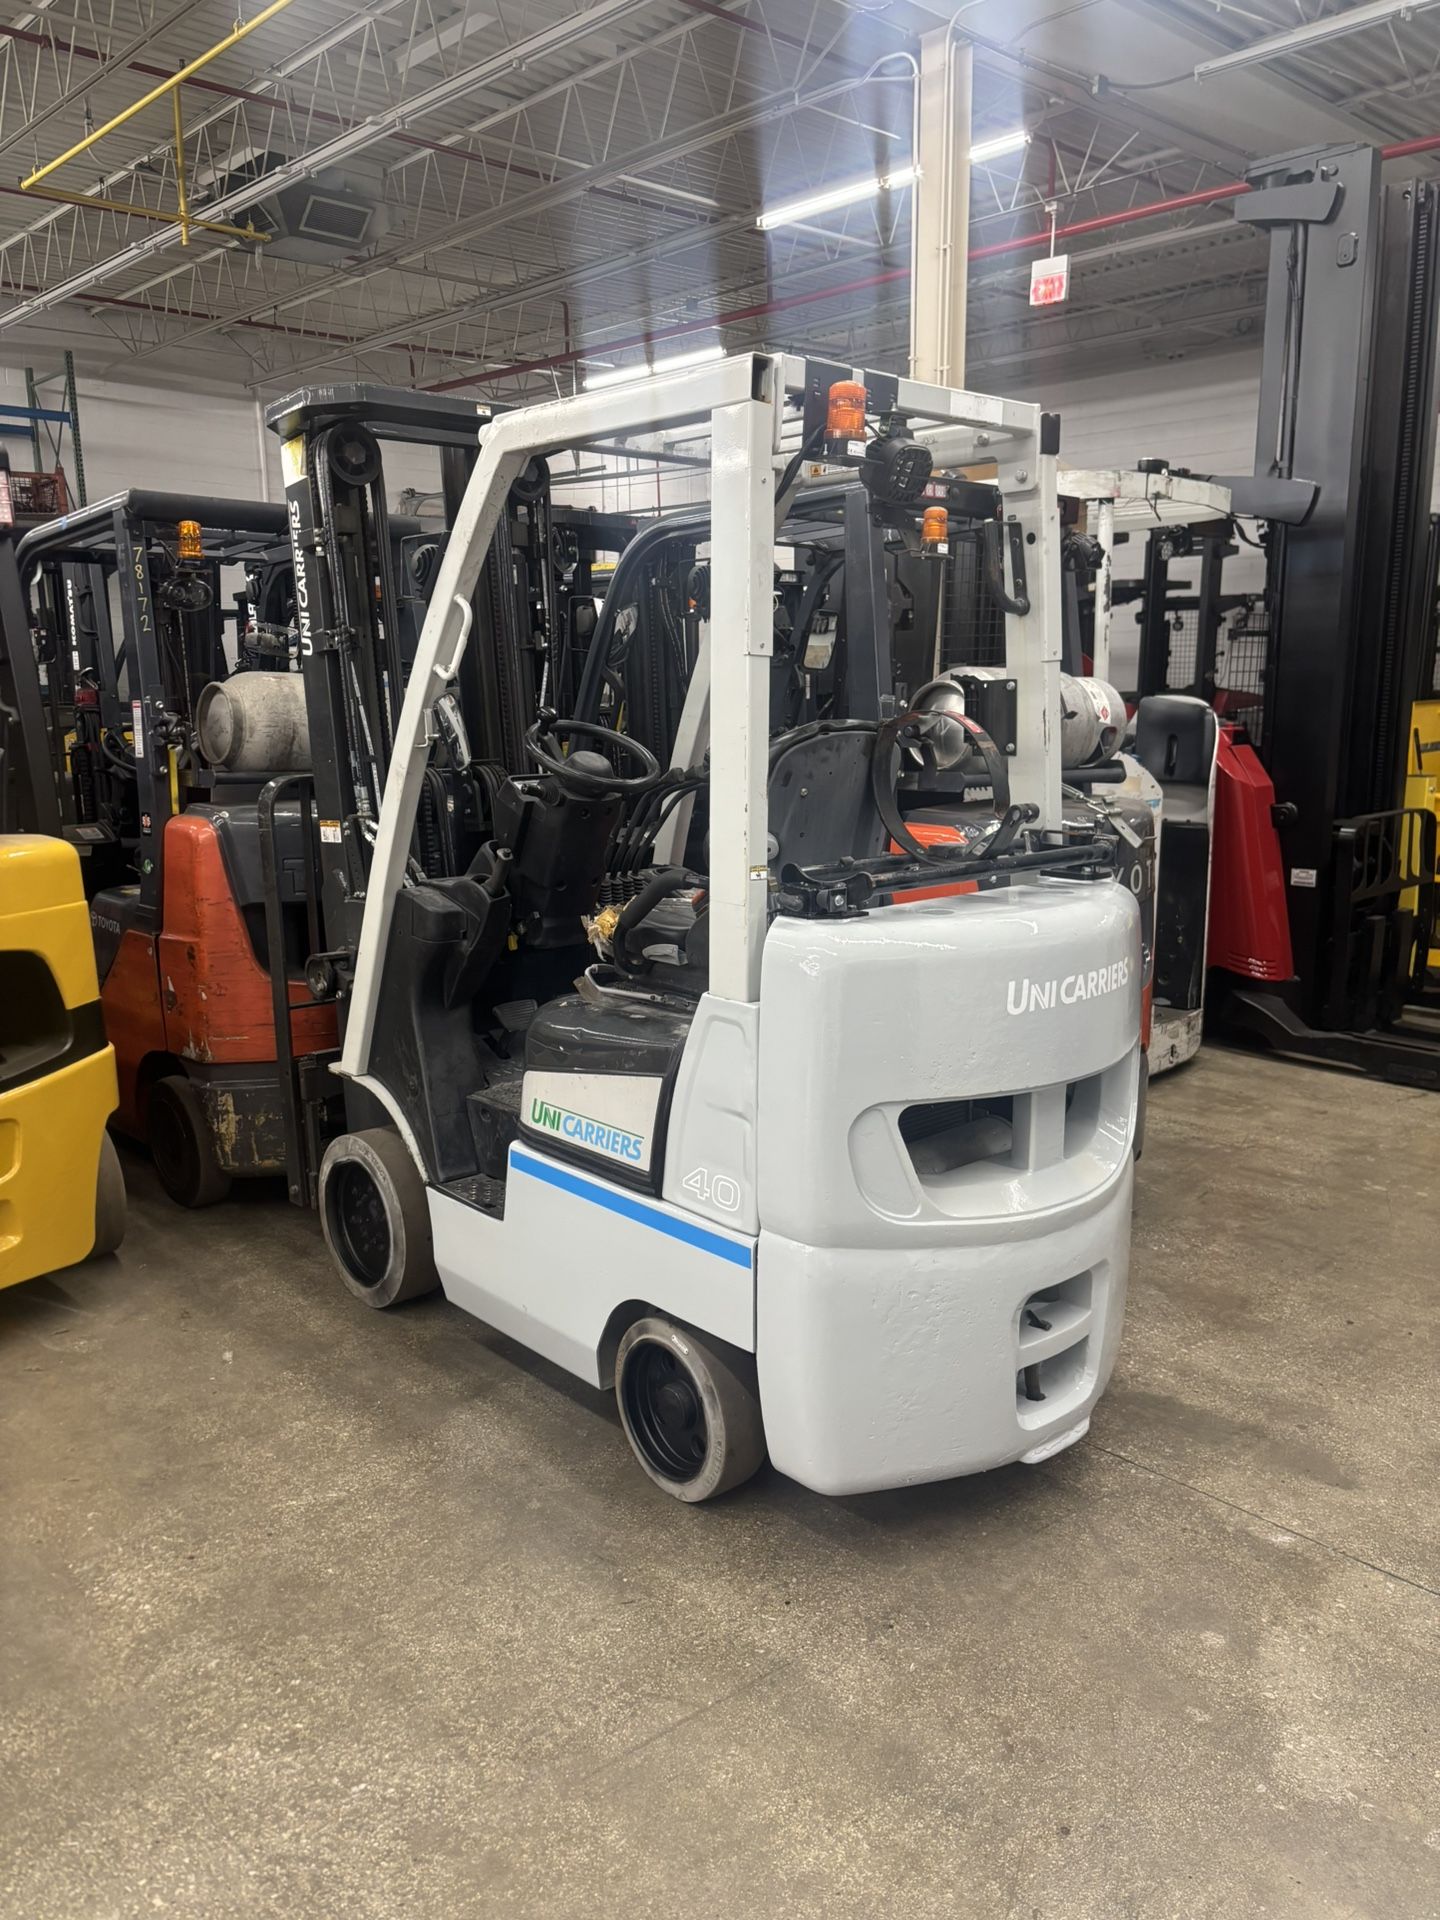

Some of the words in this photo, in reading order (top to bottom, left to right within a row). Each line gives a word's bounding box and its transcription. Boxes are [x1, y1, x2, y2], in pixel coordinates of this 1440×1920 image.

[66, 579, 77, 646] KOMATSU
[132, 546, 152, 632] 78172
[97, 915, 121, 935] TOYOTA
[682, 1168, 740, 1212] 40
